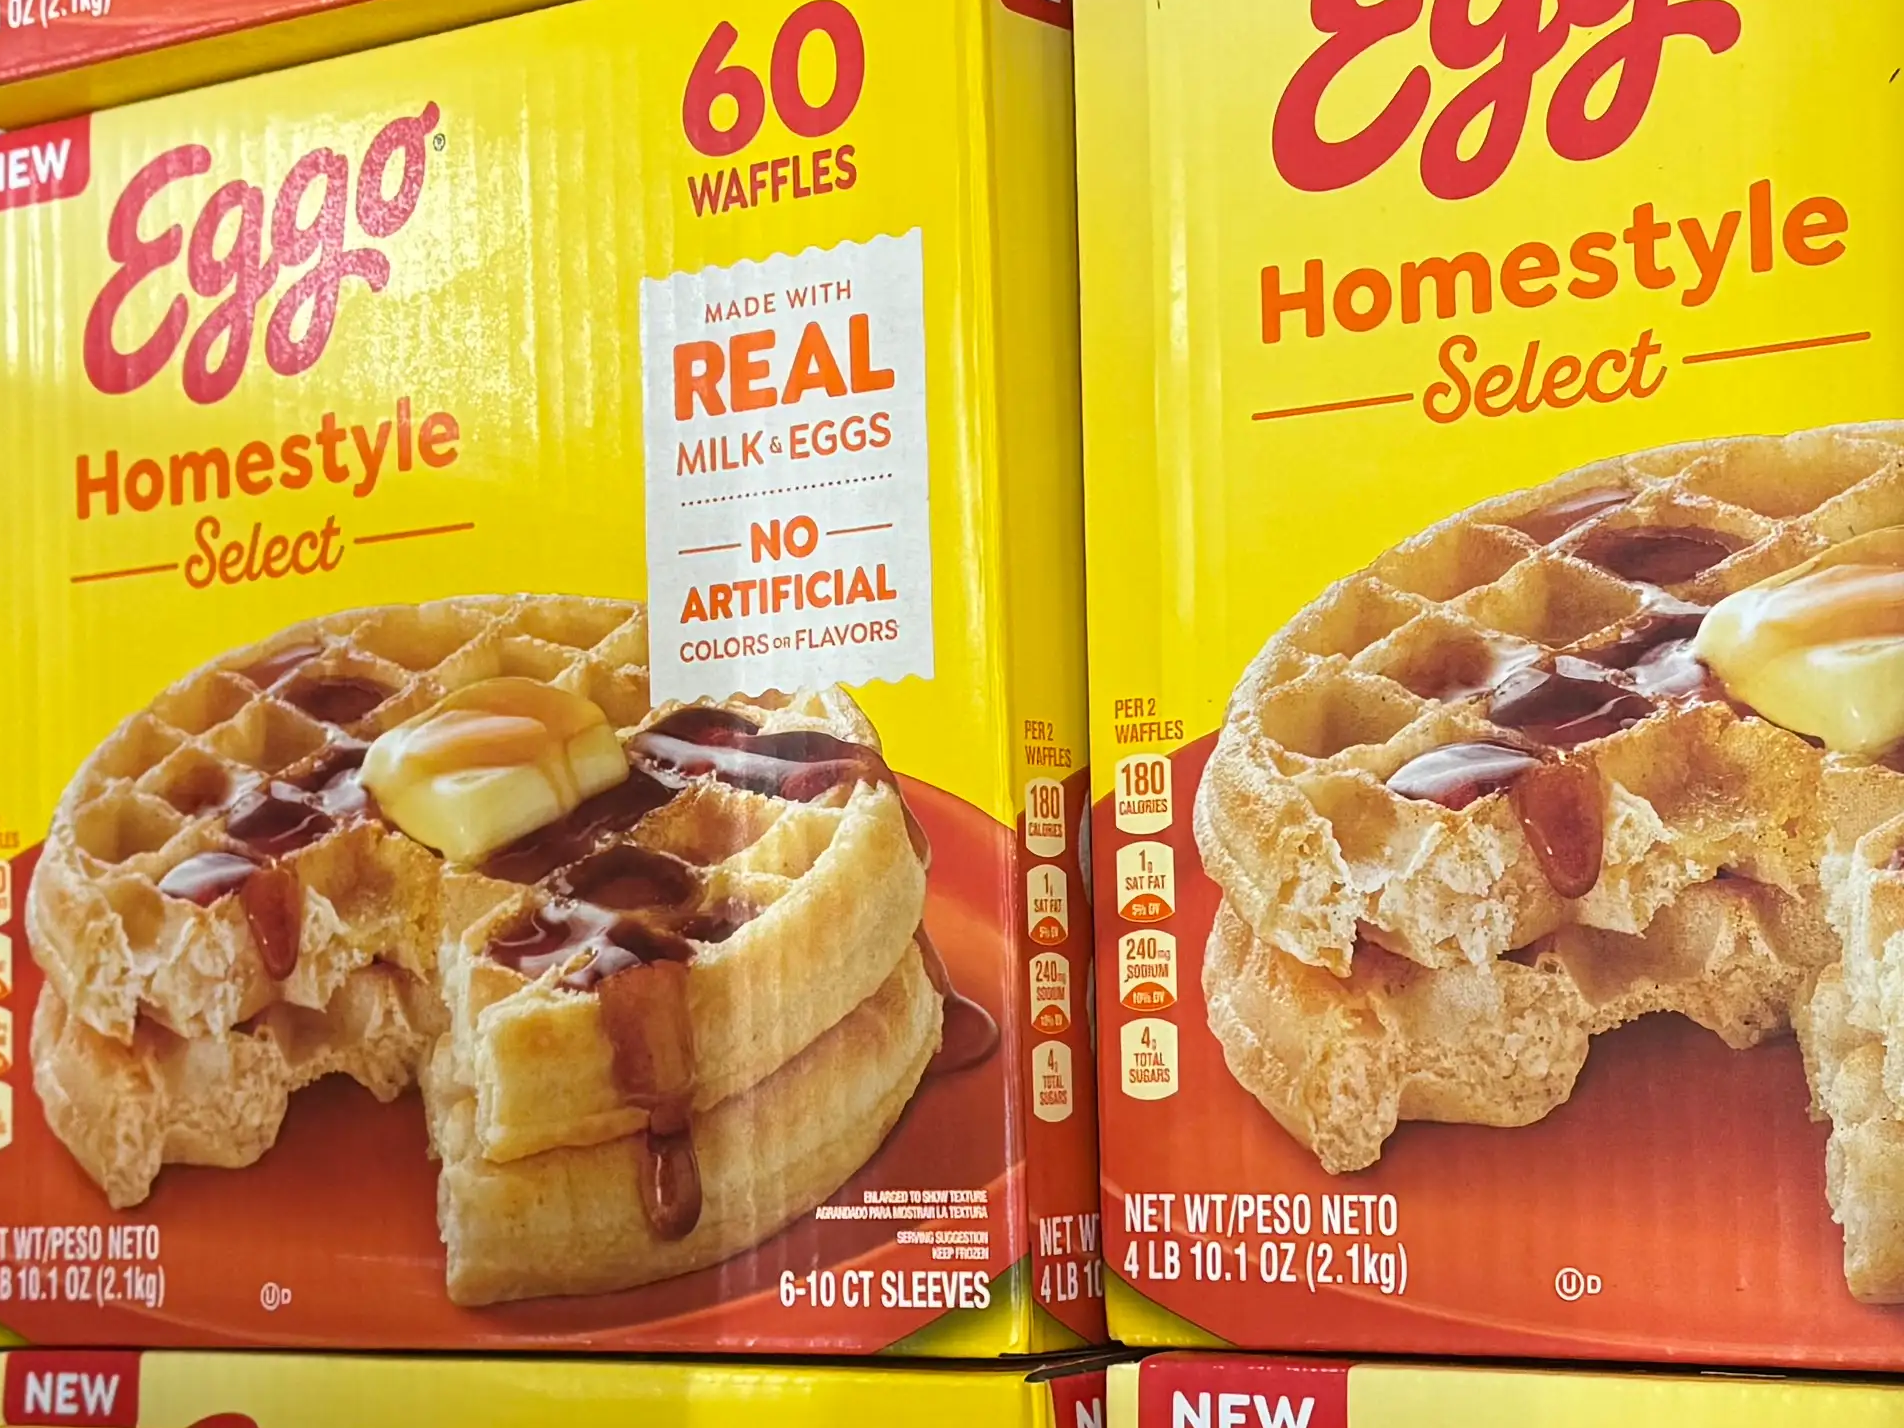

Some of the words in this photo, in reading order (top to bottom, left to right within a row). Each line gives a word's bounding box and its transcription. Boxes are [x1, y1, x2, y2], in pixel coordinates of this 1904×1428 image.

[685, 3, 861, 154] 60
[689, 146, 853, 216] WAFFLES
[1261, 179, 1848, 343] Homestyle
[675, 315, 892, 420] REAL
[1424, 329, 1666, 423] Select
[77, 396, 459, 522] Homestyle
[185, 515, 343, 588] Select
[680, 564, 895, 623] ARTIFICIAL
[1114, 698, 1145, 721] PER
[1146, 697, 1157, 717] 2
[1114, 719, 1185, 746] WAFFLES
[1118, 797, 1169, 817] CALORIES
[1121, 760, 1165, 798] 180
[1123, 1192, 1176, 1233] NET
[1183, 1192, 1312, 1239] WT/PESO
[1321, 1193, 1399, 1237] NETO
[1123, 1239, 1139, 1280] 4
[1148, 1240, 1181, 1281] LB
[1189, 1240, 1248, 1282] 10.1
[1259, 1241, 1297, 1283] OZ
[1305, 1240, 1409, 1295] (2.1kg)
